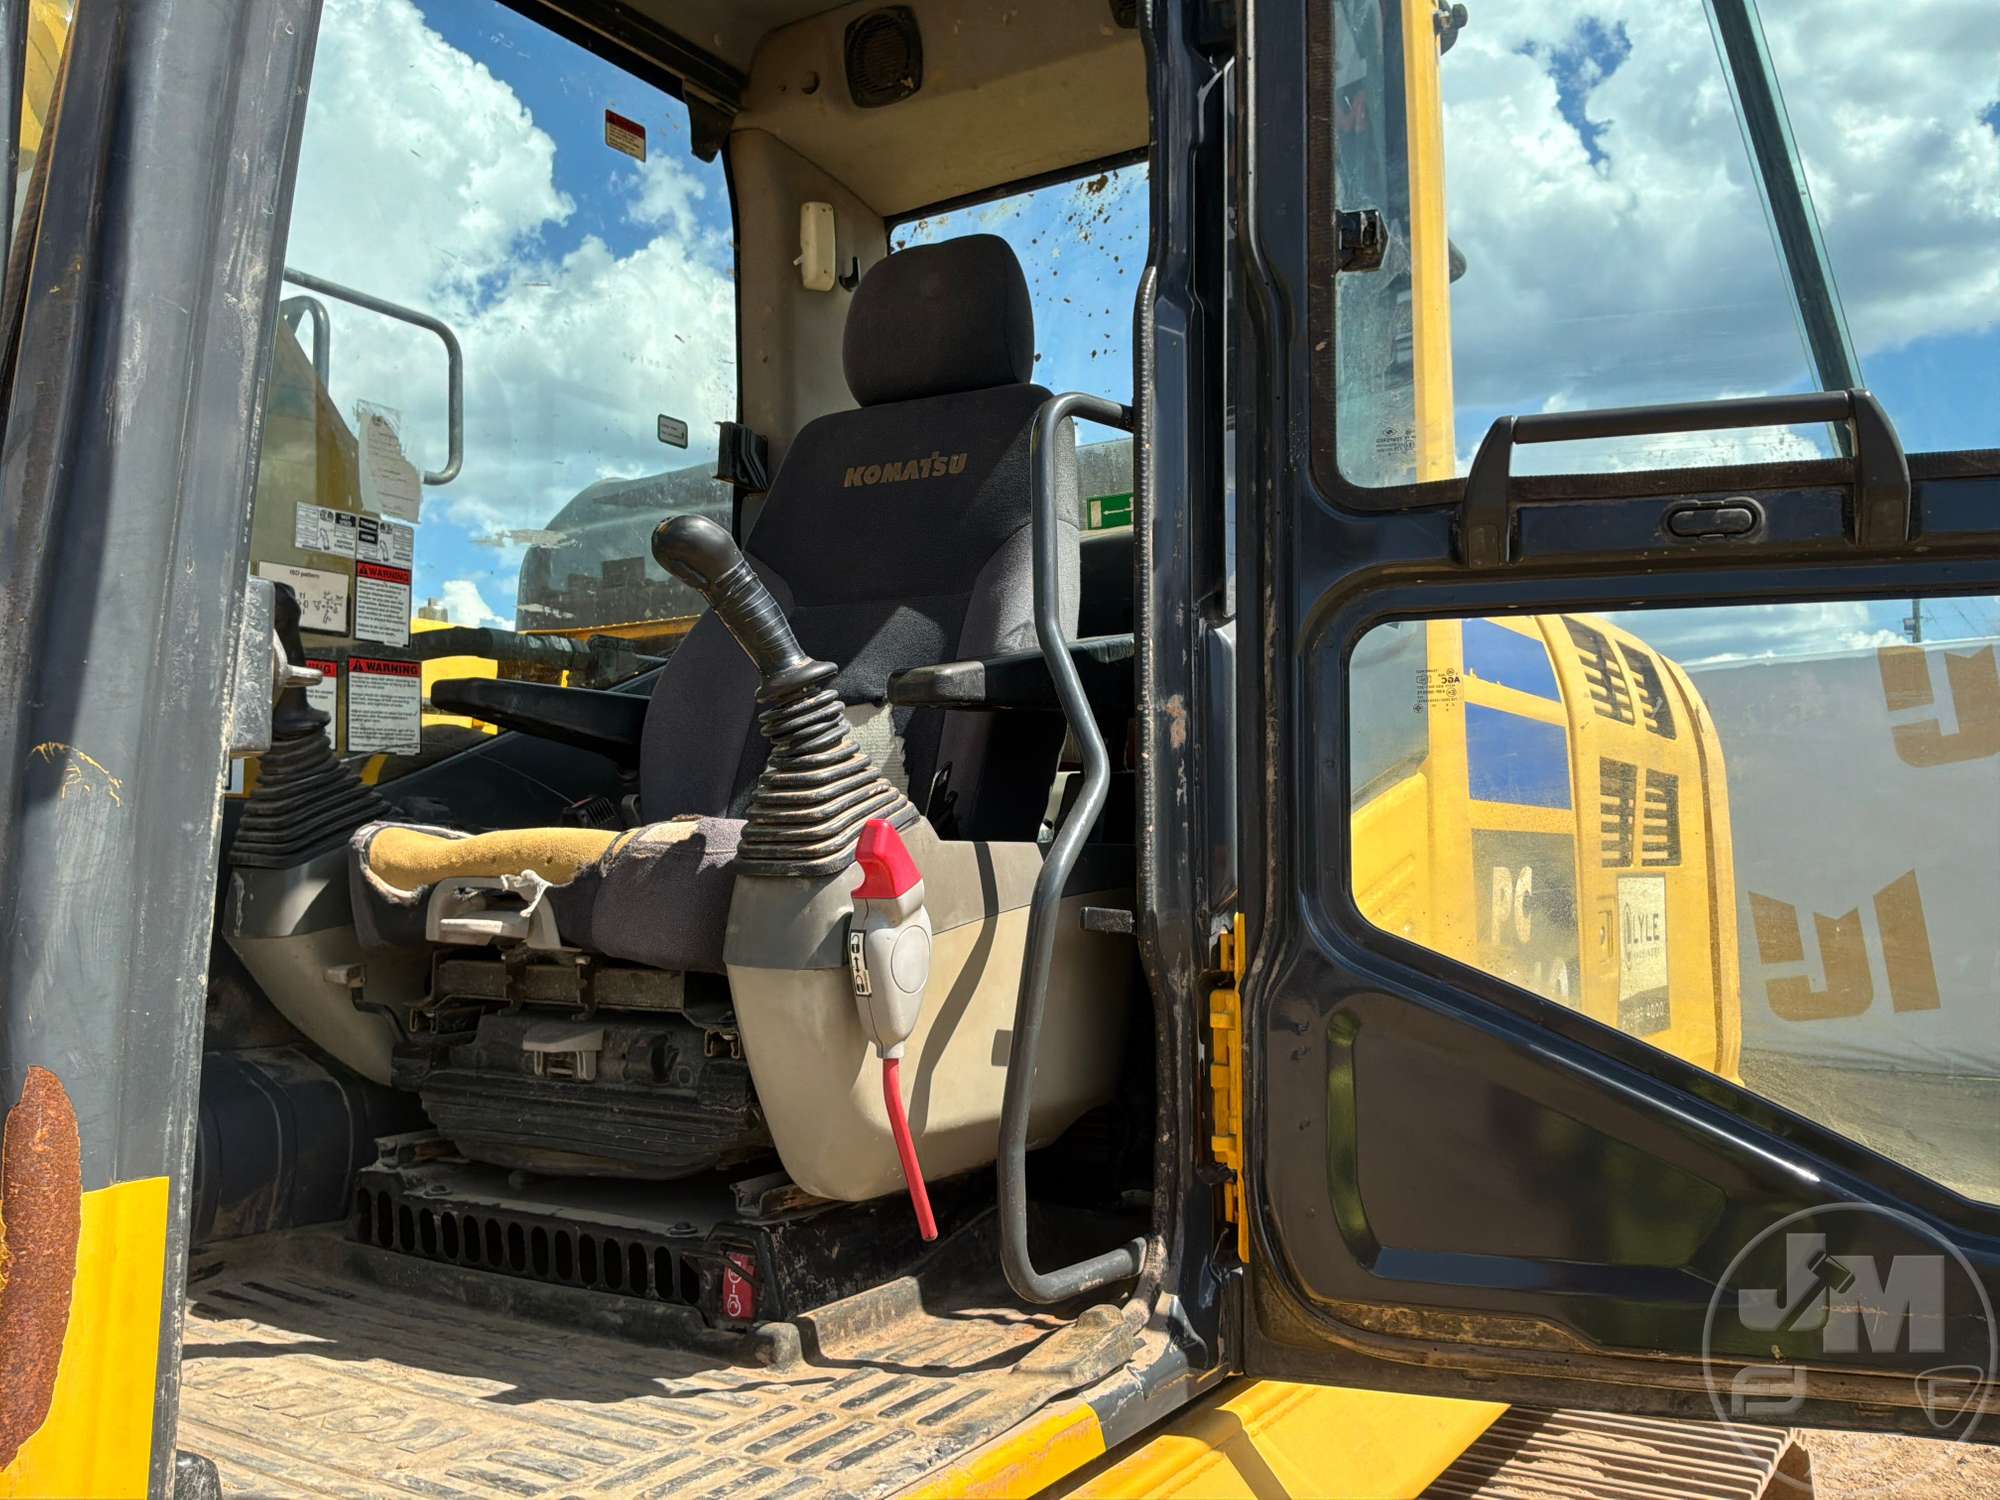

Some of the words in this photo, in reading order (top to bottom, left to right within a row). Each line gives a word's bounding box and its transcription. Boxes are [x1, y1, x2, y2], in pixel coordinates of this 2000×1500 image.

[843, 451, 968, 488] KOMATSU
[368, 564, 409, 582] WARNING
[367, 660, 418, 676] WARNING
[1491, 866, 1533, 944] PC
[1632, 911, 1660, 944] LYLE
